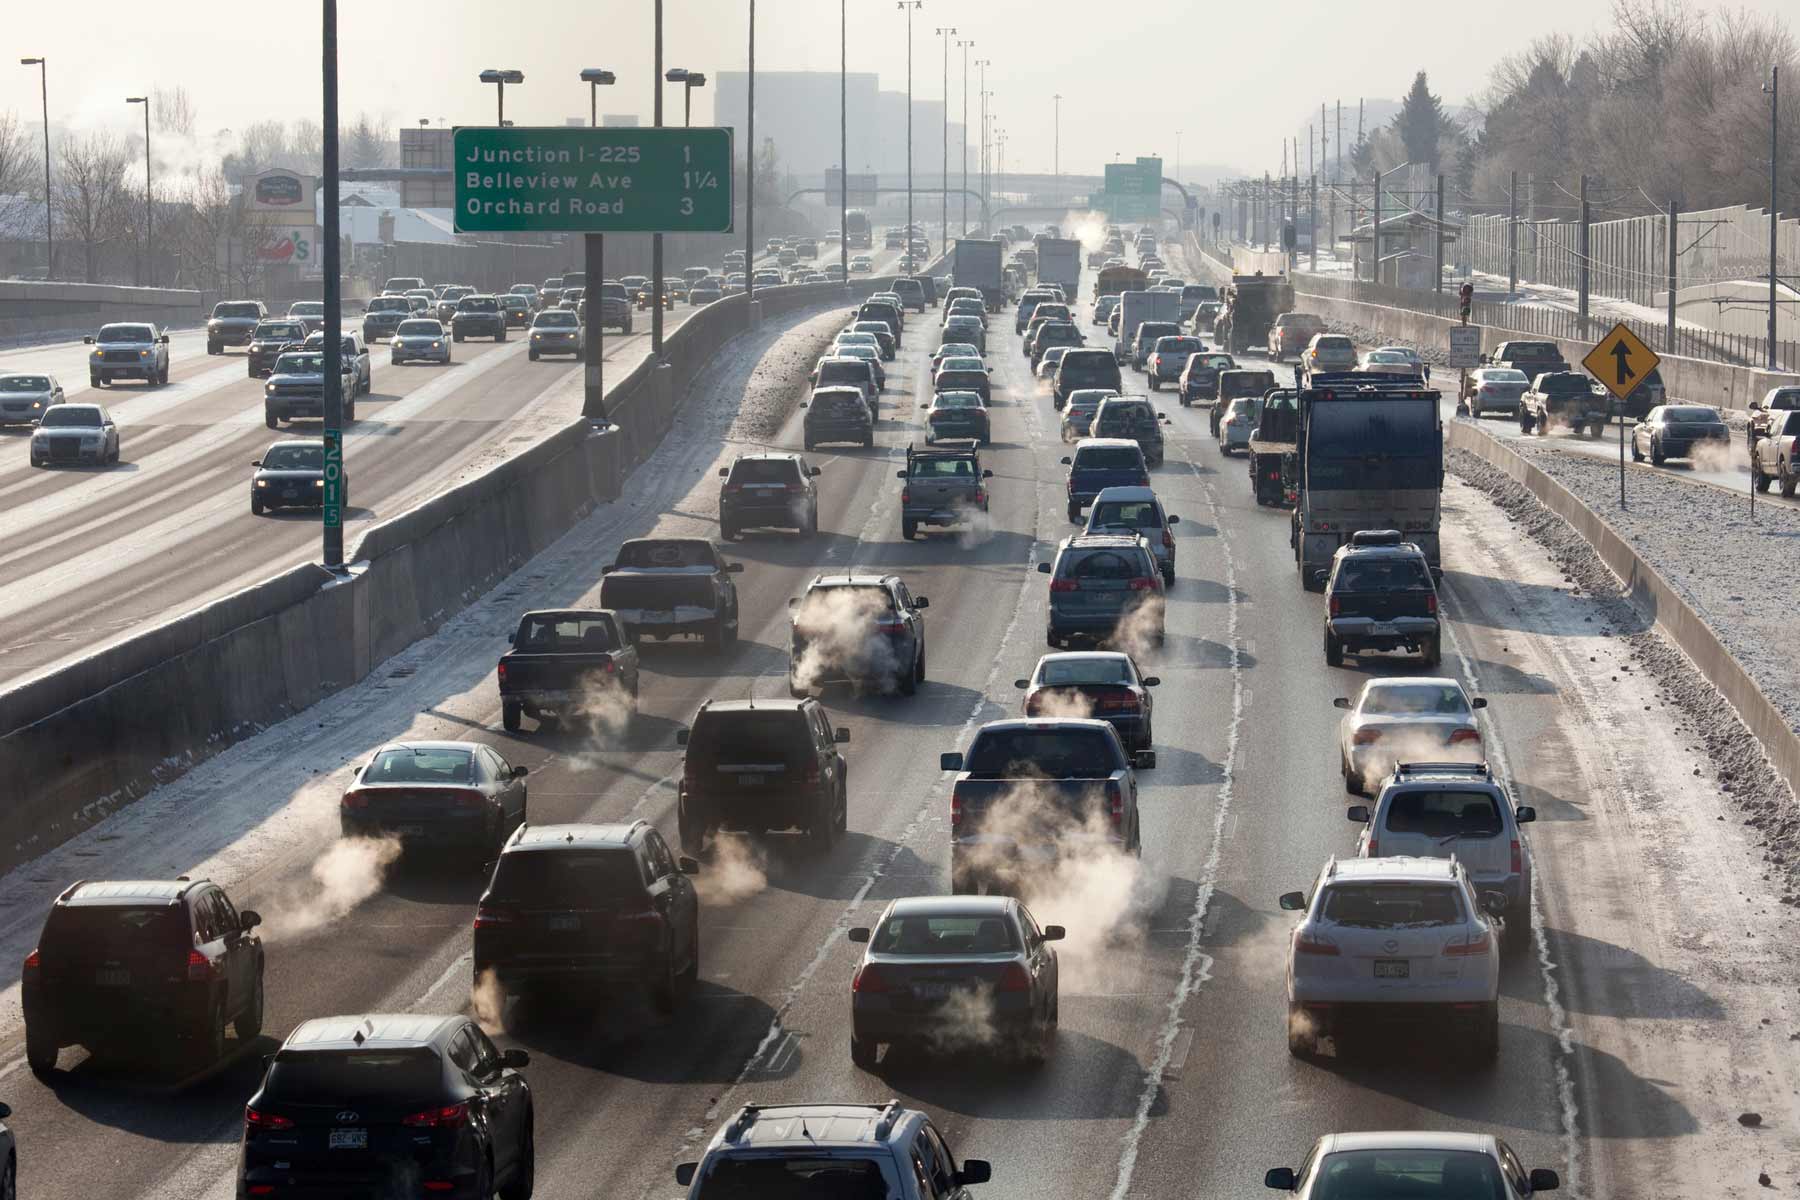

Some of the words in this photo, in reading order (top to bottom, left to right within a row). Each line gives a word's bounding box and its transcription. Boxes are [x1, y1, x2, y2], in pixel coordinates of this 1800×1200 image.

[466, 146, 570, 163] Junction
[579, 146, 641, 163] I-225
[683, 146, 690, 163] 1
[466, 171, 578, 189] Belleview
[589, 172, 632, 189] Ave
[466, 197, 560, 215] Orchard
[569, 198, 624, 215] Road
[680, 197, 694, 216] 3
